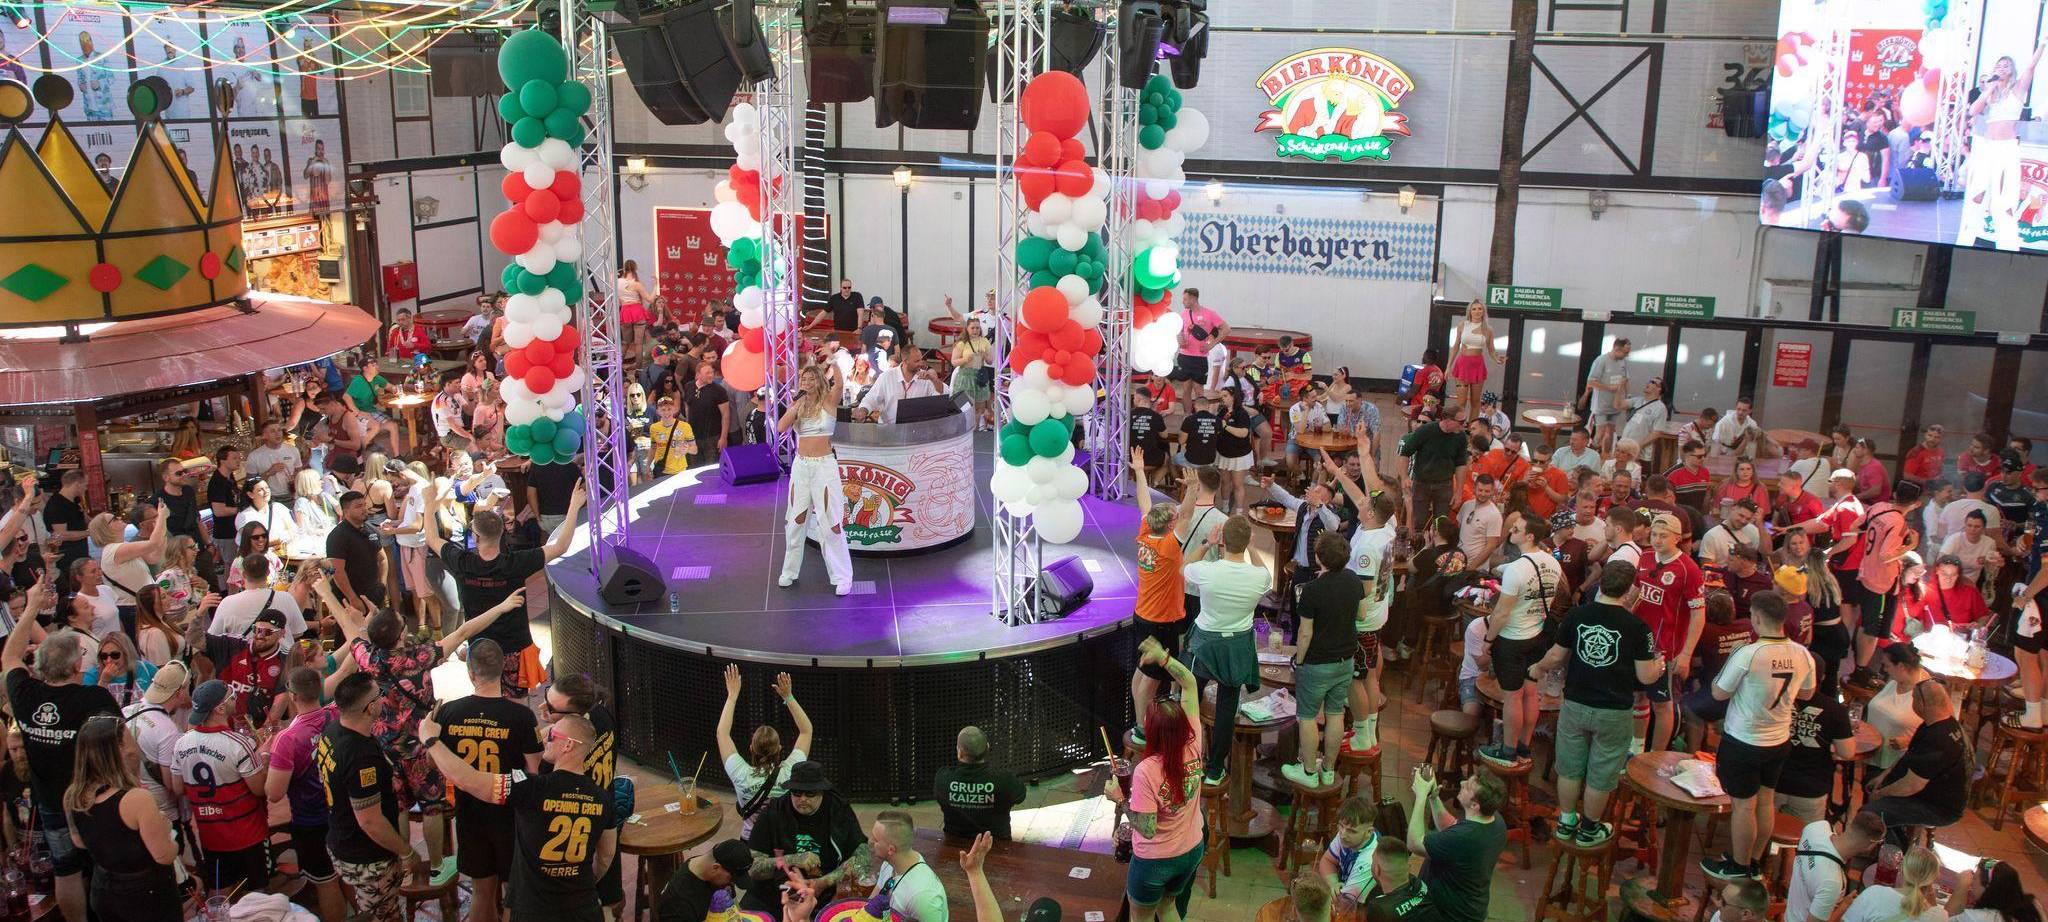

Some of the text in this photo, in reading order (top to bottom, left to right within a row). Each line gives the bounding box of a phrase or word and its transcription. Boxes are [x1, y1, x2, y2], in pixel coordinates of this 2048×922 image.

[1263, 53, 1406, 96] BIERKÖNIG
[1200, 220, 1395, 270] Oberbayern
[838, 463, 911, 496] RKÖNIG
[1771, 659, 1795, 670] RAUL
[1768, 672, 1794, 711] 7
[448, 724, 510, 740] OPENING CREW
[178, 745, 226, 762] Bayern München
[457, 738, 500, 774] 26
[192, 761, 217, 799] 9
[949, 781, 995, 793] GRUPO
[543, 799, 604, 816] OPENING CREW
[948, 792, 995, 804] KAIZEN
[539, 815, 592, 864] 26
